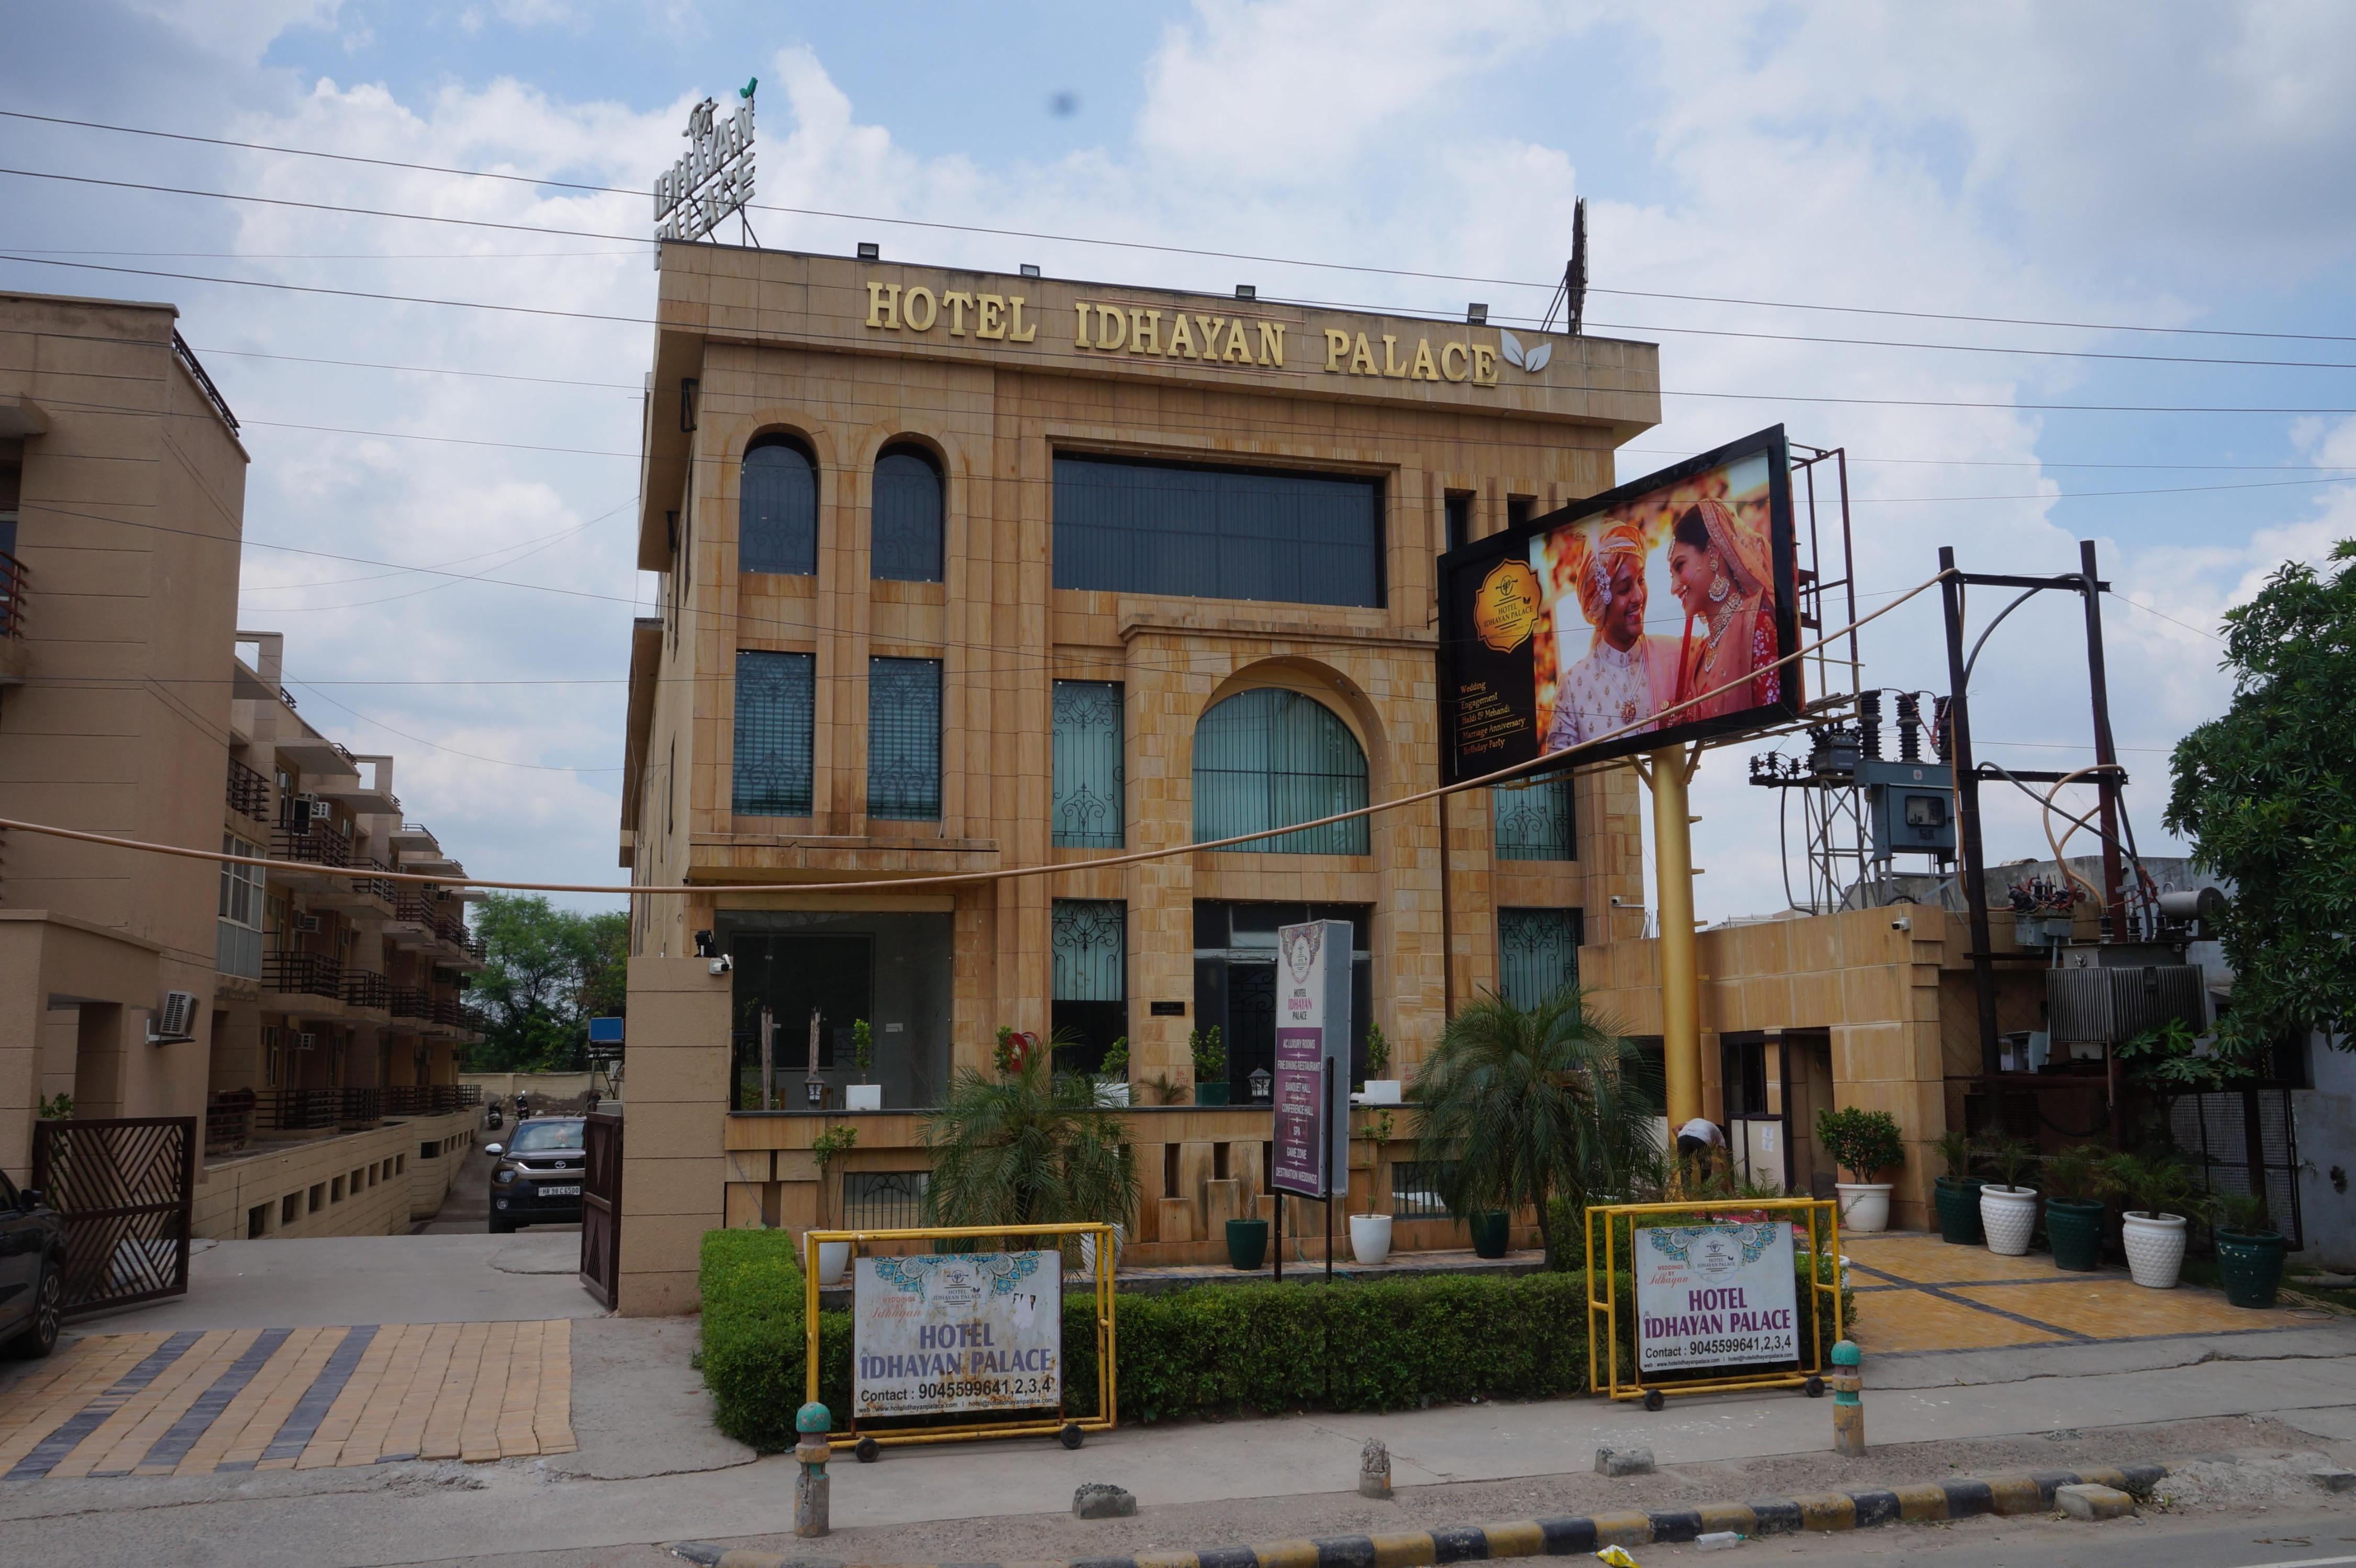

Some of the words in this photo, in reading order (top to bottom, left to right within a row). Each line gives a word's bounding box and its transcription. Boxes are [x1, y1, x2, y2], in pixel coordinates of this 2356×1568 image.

[654, 96, 754, 221] IDHAYAN
[865, 281, 1037, 342] HOTEL
[1075, 302, 1286, 366] IDHAYAN
[1325, 328, 1498, 386] PALACE
[1484, 613, 1510, 627] IDHAYAN
[1510, 605, 1533, 619] PALACE
[1498, 603, 1517, 615] HOTEL
[1461, 682, 1486, 693] Wedding
[1461, 692, 1498, 710] Engagement
[1462, 715, 1476, 725] Haldi
[1477, 711, 1484, 720] &
[1485, 704, 1510, 719] Mehandi
[1463, 728, 1488, 739] Marriage
[1489, 717, 1526, 734] Anniversary
[1463, 743, 1488, 755] Birthday
[1489, 738, 1505, 749] Party
[1294, 988, 1307, 997] HOTEL
[1288, 997, 1313, 1010] IDHAYAN
[1292, 1011, 1307, 1020] PALACE
[1283, 1039, 1288, 1048] AC
[1288, 1039, 1302, 1049] LUXURY
[1302, 1039, 1316, 1049] ROOMS
[1285, 1061, 1297, 1071] DINING
[1297, 1061, 1321, 1072] RESTAURANT
[1285, 1082, 1301, 1093] BANQUET
[1302, 1082, 1311, 1094] HALL
[1282, 1103, 1304, 1115] CONFERENCE
[1304, 1105, 1314, 1116] HALL
[1286, 1147, 1297, 1159] GAME
[1297, 1149, 1307, 1160] ZONE
[1276, 1166, 1298, 1180] DESTINATION
[1298, 1172, 1317, 1185] WEDDINGS
[1647, 1273, 1688, 1288] Idhayan
[1688, 1287, 1748, 1311] HOTEL
[870, 1304, 921, 1322] Idhayan
[1645, 1314, 1723, 1339] IDHAYAN
[1730, 1309, 1791, 1333] PALACE
[920, 1323, 995, 1349] HOTEL
[1646, 1346, 1681, 1359] Contact
[1690, 1335, 1791, 1355] 9045599641,2,3,4
[860, 1351, 961, 1380] IDHAYAN
[971, 1348, 1051, 1374] PALACE
[1657, 1358, 1720, 1367] www.hotelidhayanpalace.com
[1728, 1353, 1794, 1362] hotel@hotelidhayanpalace.com
[861, 1388, 907, 1403] Contact
[918, 1377, 1051, 1399] 9045599641,2,3,4
[875, 1402, 958, 1413] www.hotelidhayanpalace.com
